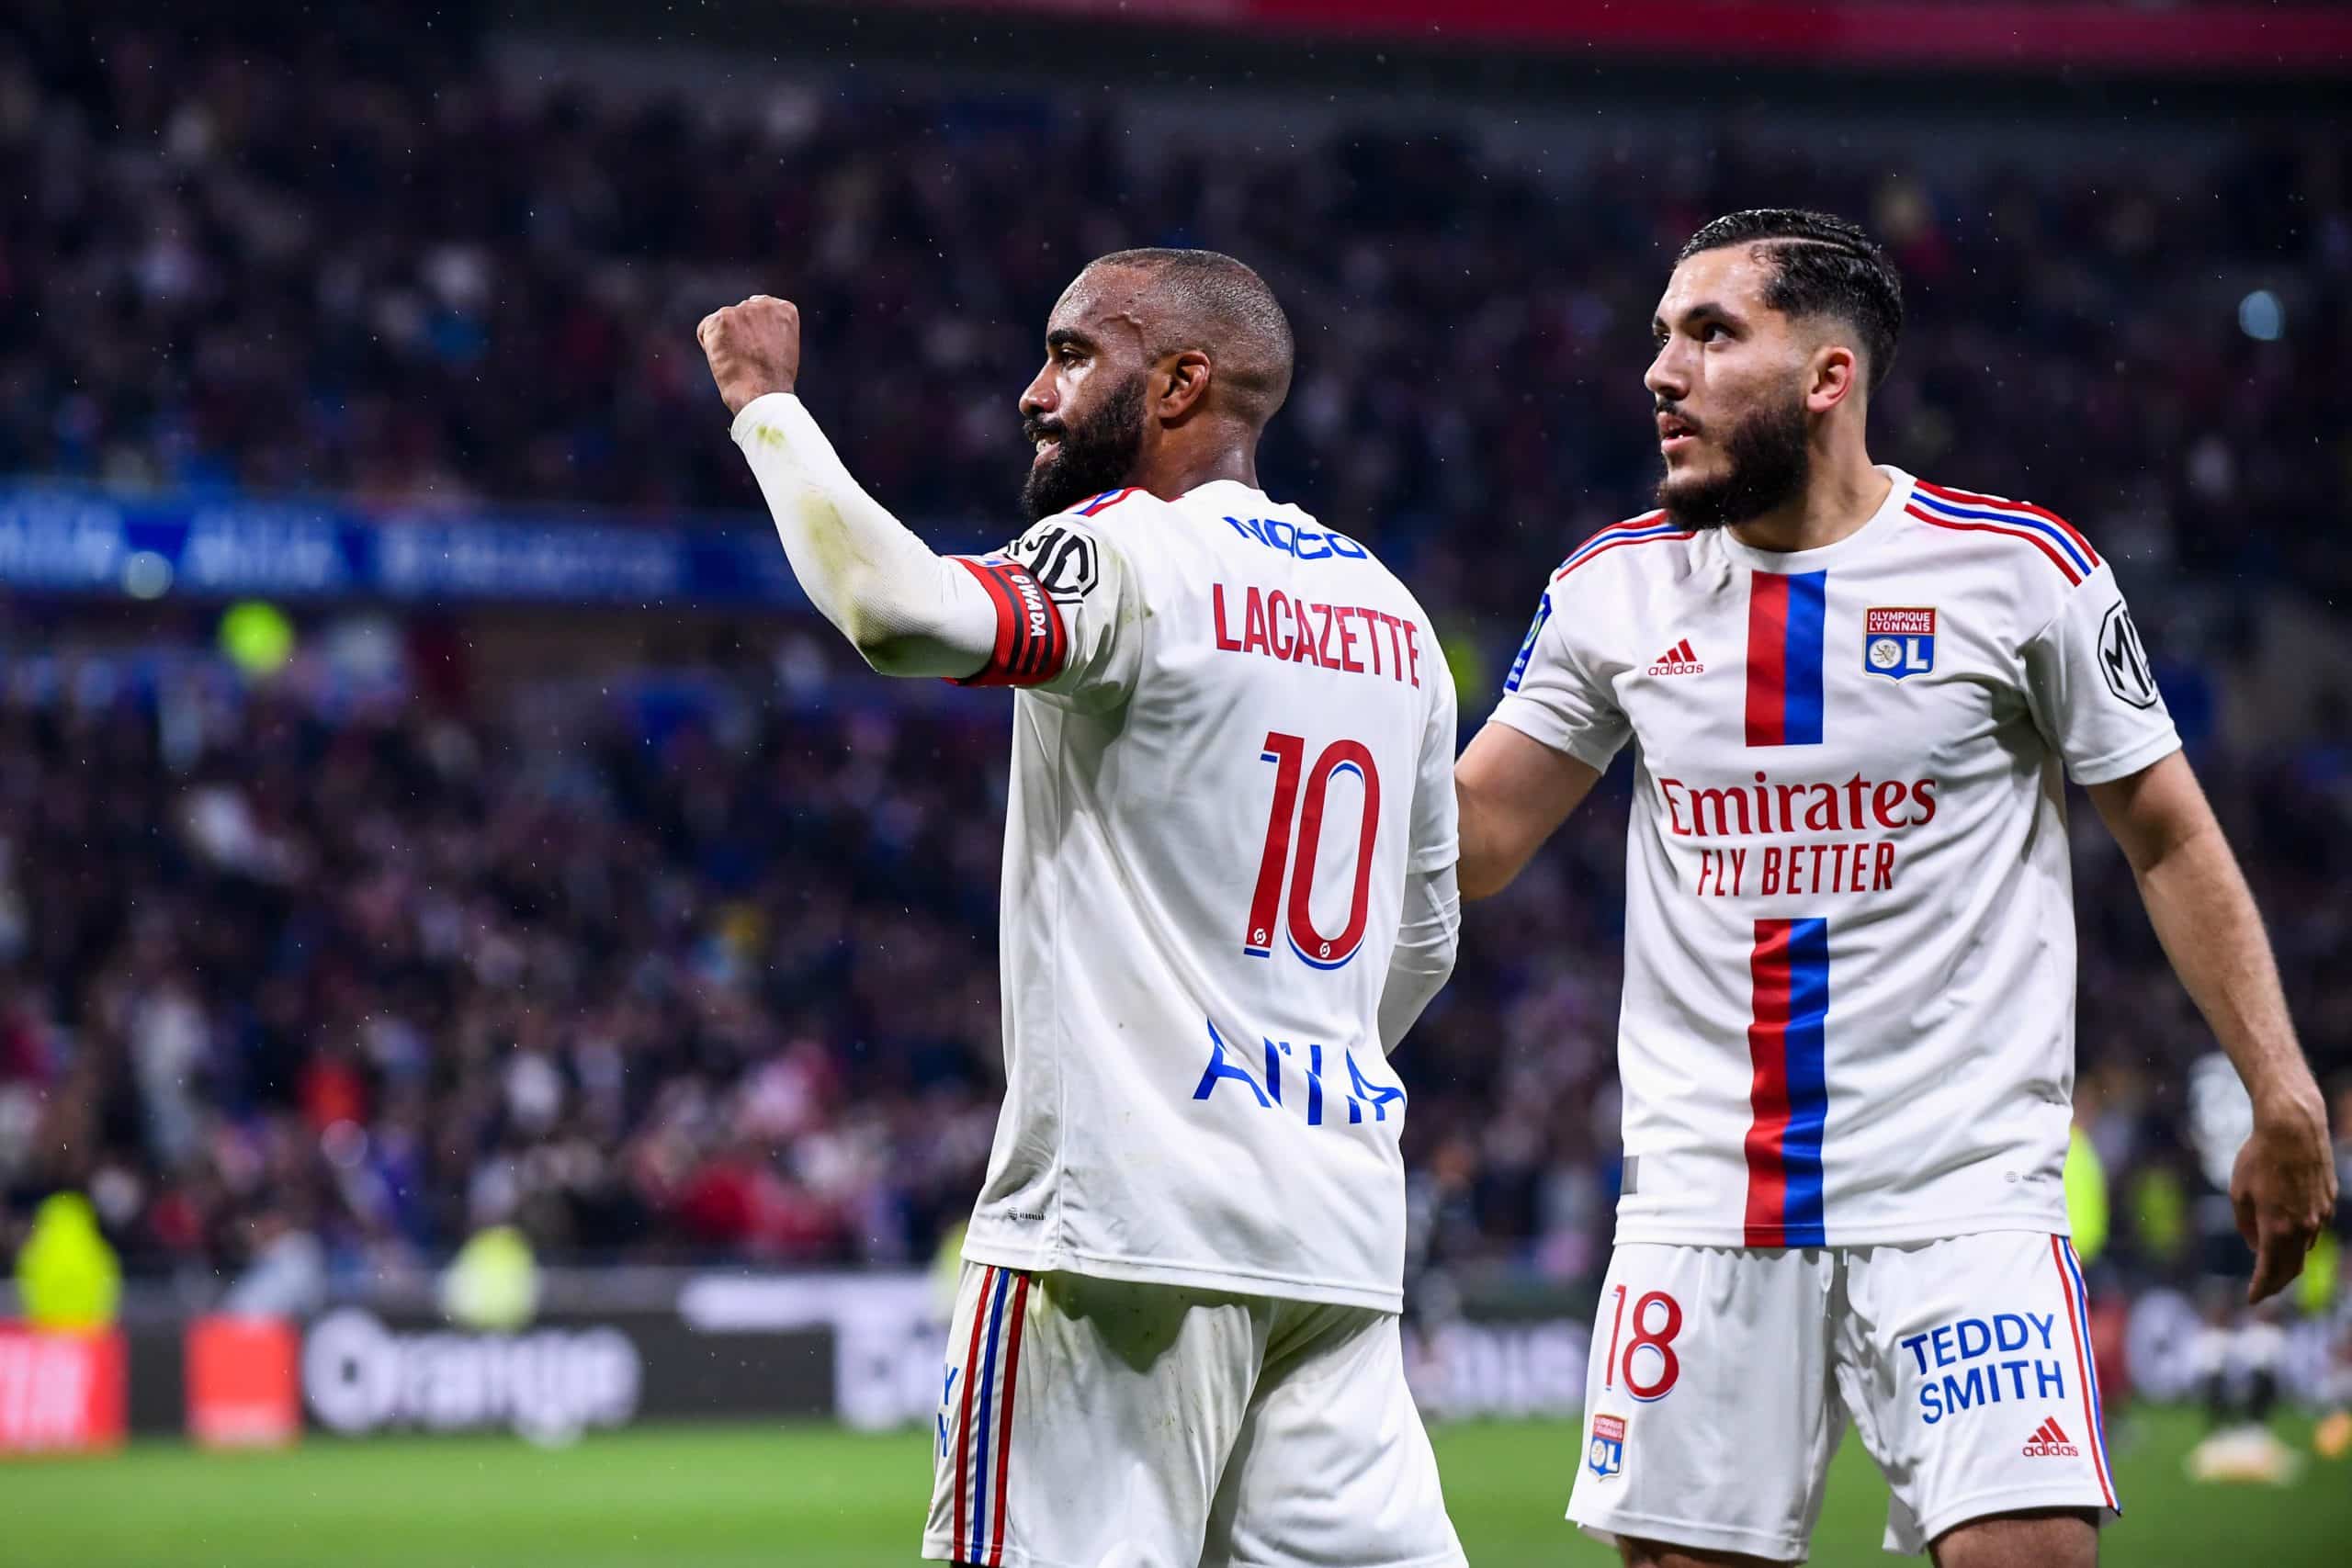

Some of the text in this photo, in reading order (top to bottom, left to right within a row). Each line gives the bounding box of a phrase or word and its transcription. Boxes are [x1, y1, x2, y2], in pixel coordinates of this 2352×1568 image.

[1213, 583, 1419, 691] LACAZETTE
[1869, 611, 1931, 622] OLYMPIQUE
[1869, 621, 1930, 632] LYONNAIS
[1647, 661, 1704, 676] adidas
[1658, 772, 1936, 837] Emirates
[1243, 731, 1380, 970] 10
[1698, 841, 1894, 897] FLY BETTER
[1605, 1284, 1683, 1403] 18
[1902, 1313, 2054, 1375] TEDDY
[1920, 1359, 2065, 1425] SMITH
[2022, 1441, 2079, 1457] adidas
